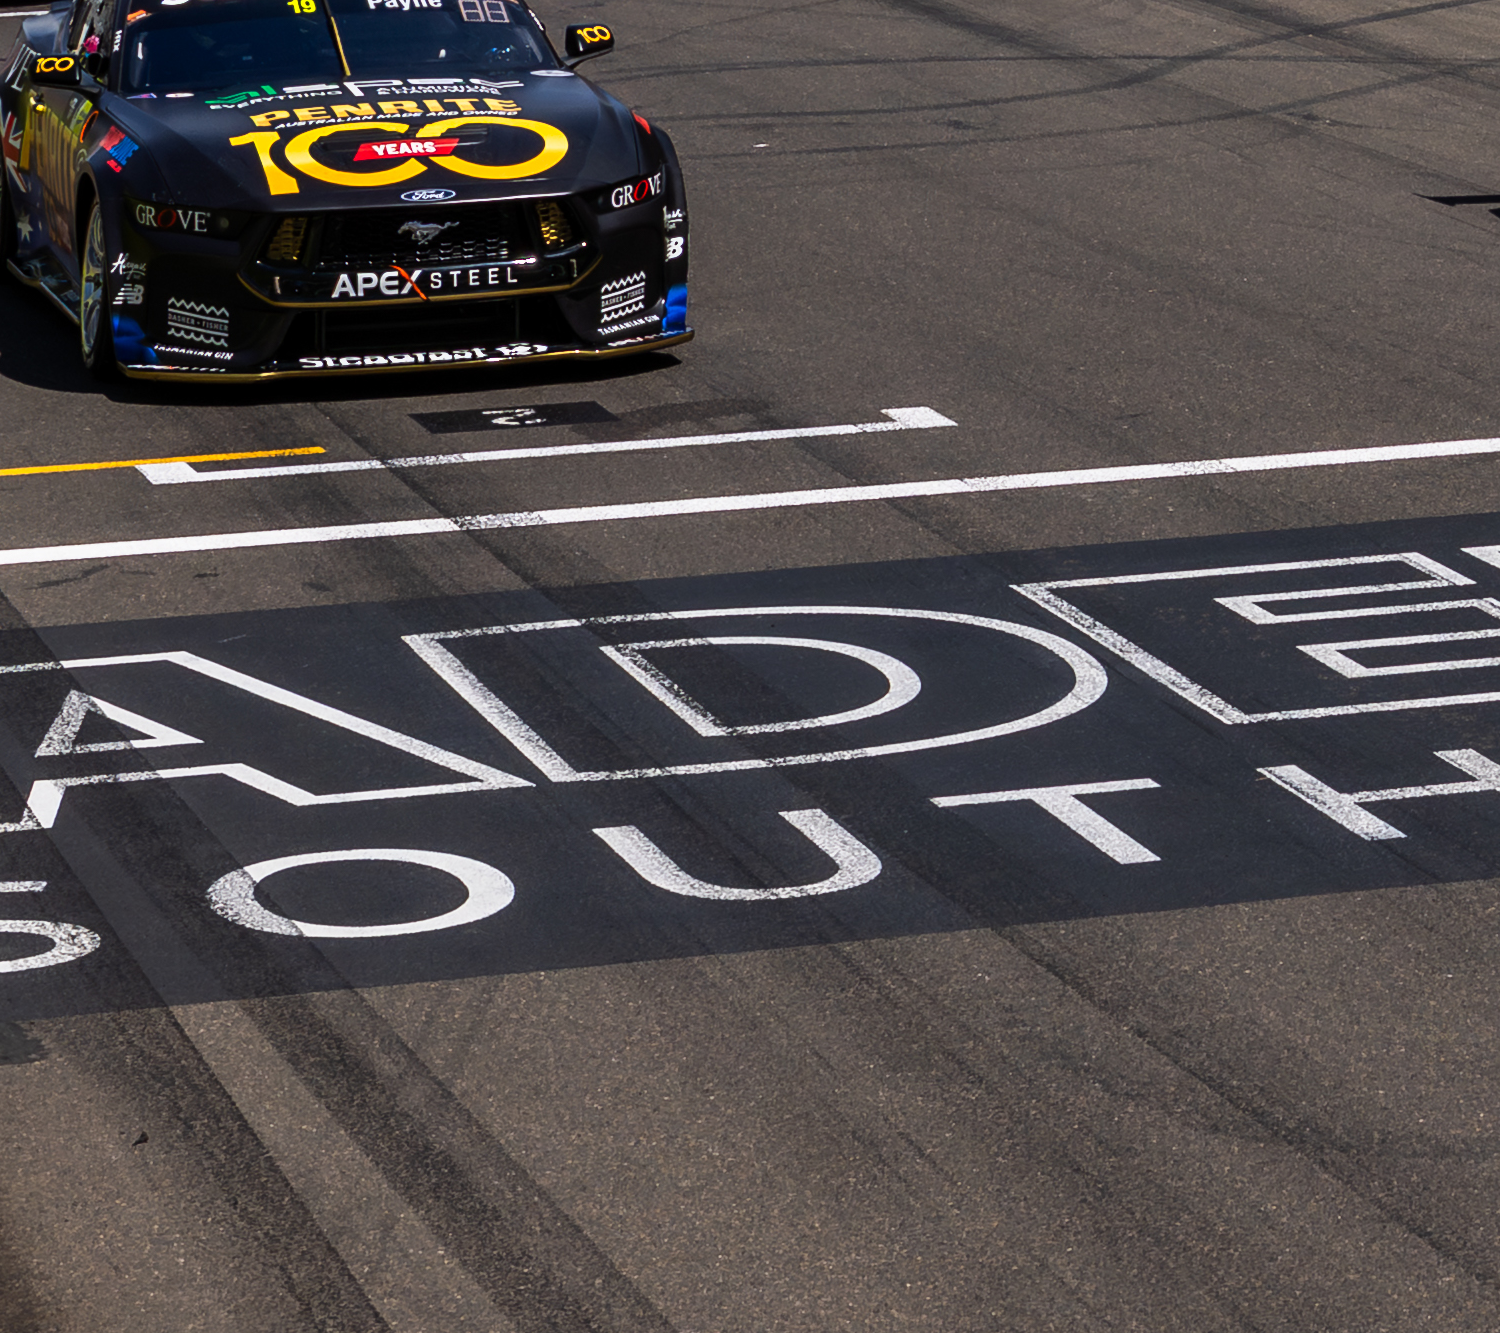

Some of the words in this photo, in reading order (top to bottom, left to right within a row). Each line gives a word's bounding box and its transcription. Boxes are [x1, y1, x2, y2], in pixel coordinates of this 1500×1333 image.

[576, 26, 612, 42] 100
[35, 56, 75, 73] 100
[210, 90, 341, 110] EVERYTHING
[250, 98, 522, 126] PENRITE
[275, 114, 373, 130] AUSTRALIAN
[376, 111, 424, 120] MADE
[426, 110, 459, 118] AND
[462, 109, 518, 118] OWNED
[229, 117, 569, 195] 100
[371, 141, 436, 156] YEARS
[611, 172, 662, 208] GROVE
[136, 204, 208, 232] GROVE
[331, 264, 428, 300] APEX
[430, 267, 518, 290] STEEL
[202, 320, 229, 332] FISHER
[598, 318, 644, 335] TASMANIAN
[154, 343, 213, 358] TASMANIAN
[214, 350, 233, 360] GIN
[299, 346, 488, 370] Steadfast
